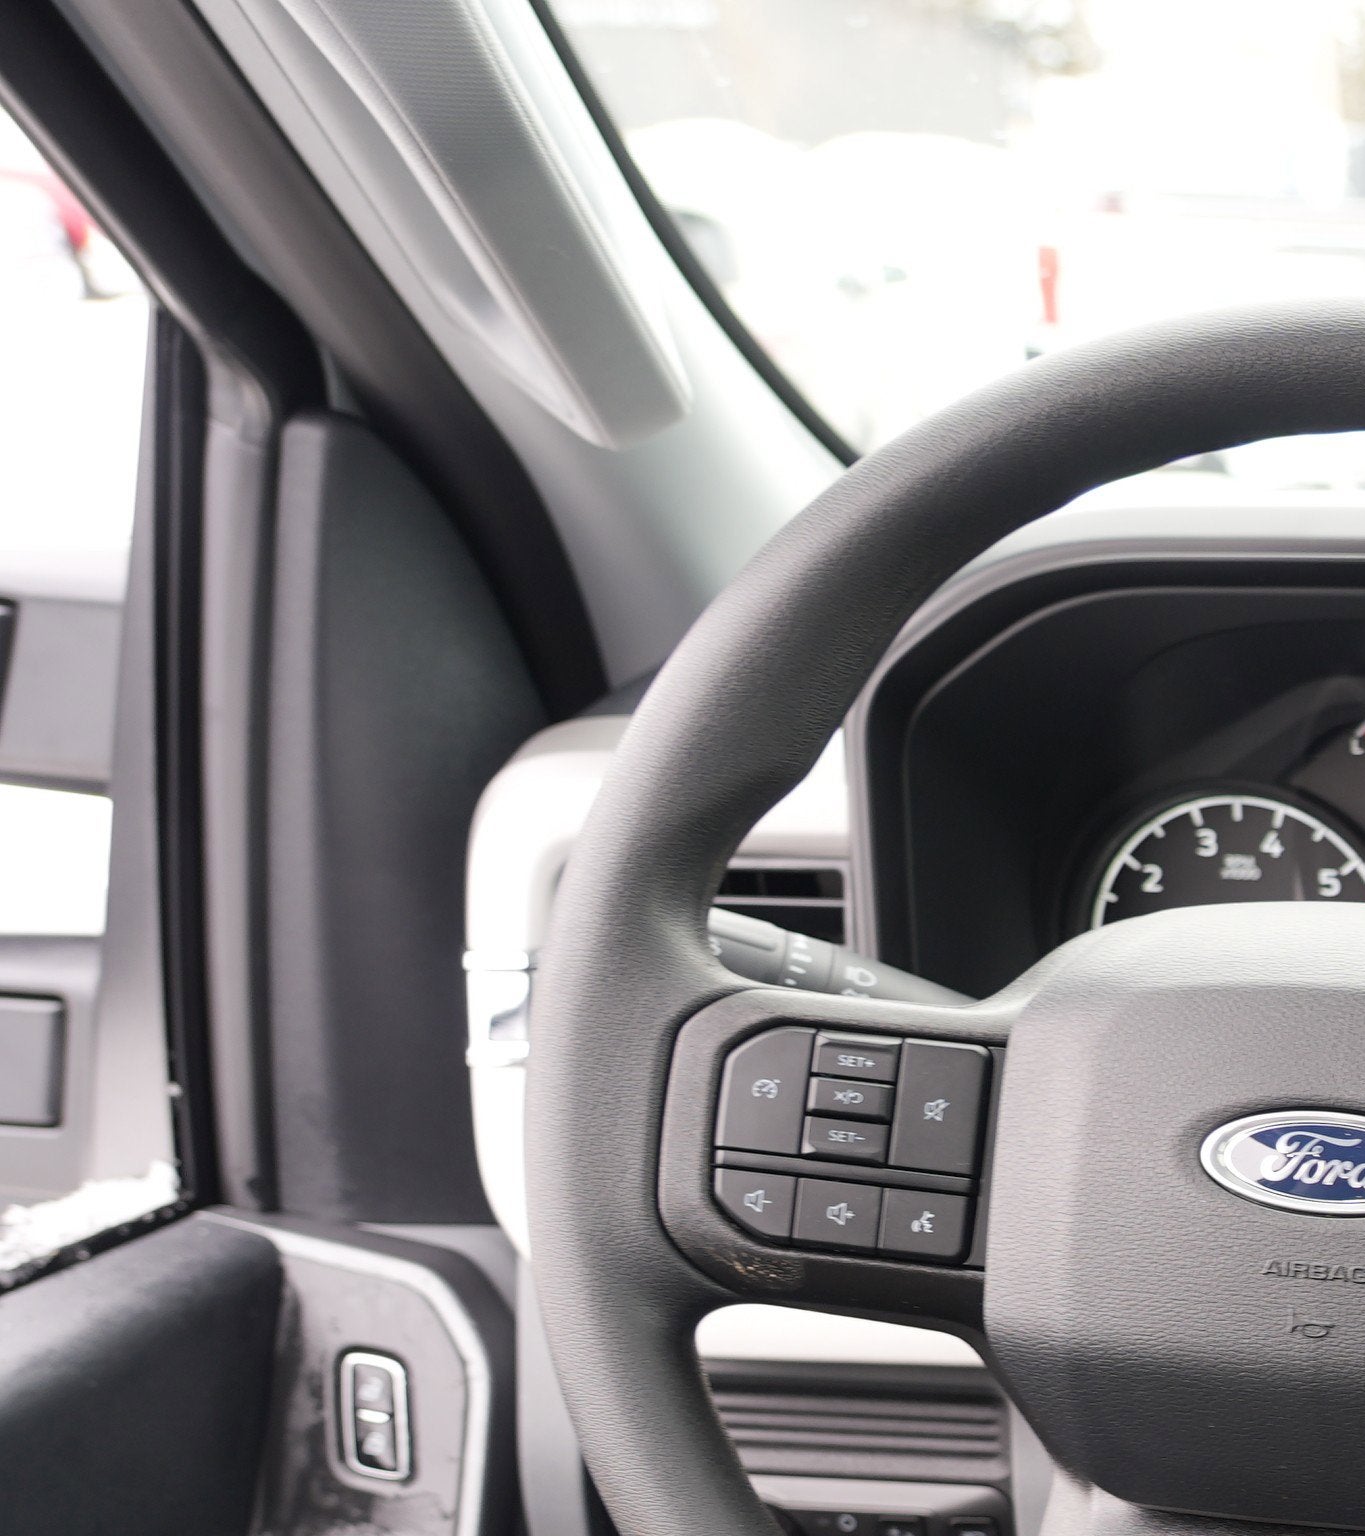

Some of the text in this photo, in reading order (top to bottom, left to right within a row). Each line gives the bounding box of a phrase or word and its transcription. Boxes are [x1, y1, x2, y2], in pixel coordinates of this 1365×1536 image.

[1195, 828, 1218, 857] 3
[1259, 830, 1284, 859] 4
[1140, 864, 1164, 893] 2
[1317, 868, 1341, 897] 5
